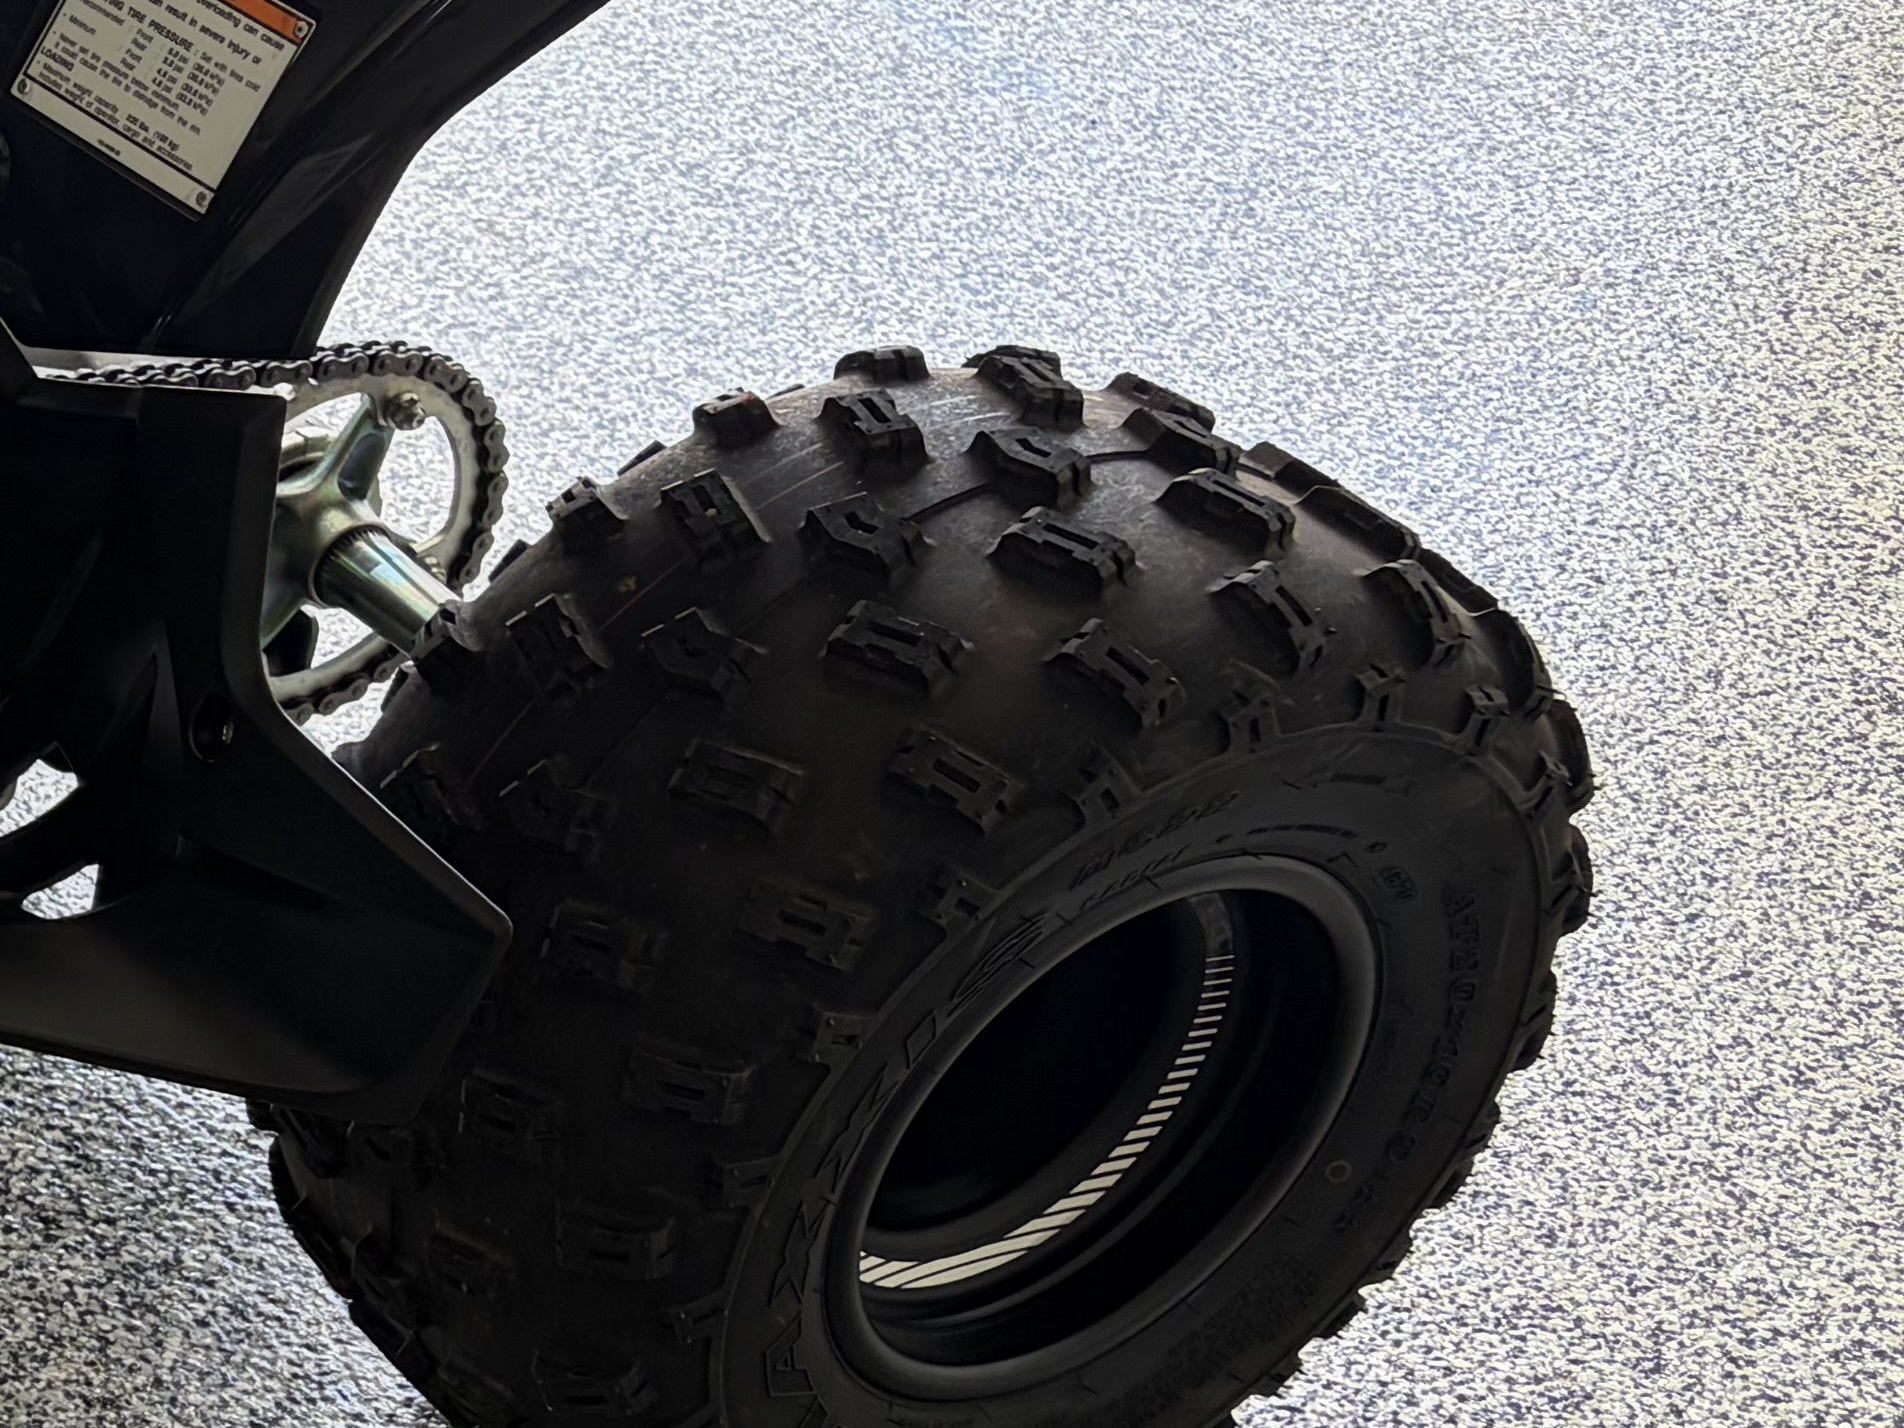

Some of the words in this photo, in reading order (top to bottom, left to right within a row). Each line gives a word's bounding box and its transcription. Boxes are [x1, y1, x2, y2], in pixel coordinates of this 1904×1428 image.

[127, 5, 146, 23] TIRE
[147, 19, 194, 52] PRESSURE
[213, 60, 227, 72] with
[244, 79, 260, 92] cold
[164, 3, 188, 22] result
[187, 16, 197, 27] in
[198, 24, 225, 44] severe
[226, 39, 250, 60] injury
[251, 55, 261, 64] or
[242, 22, 258, 36] can
[260, 33, 284, 51] cause
[72, 81, 93, 97] weight
